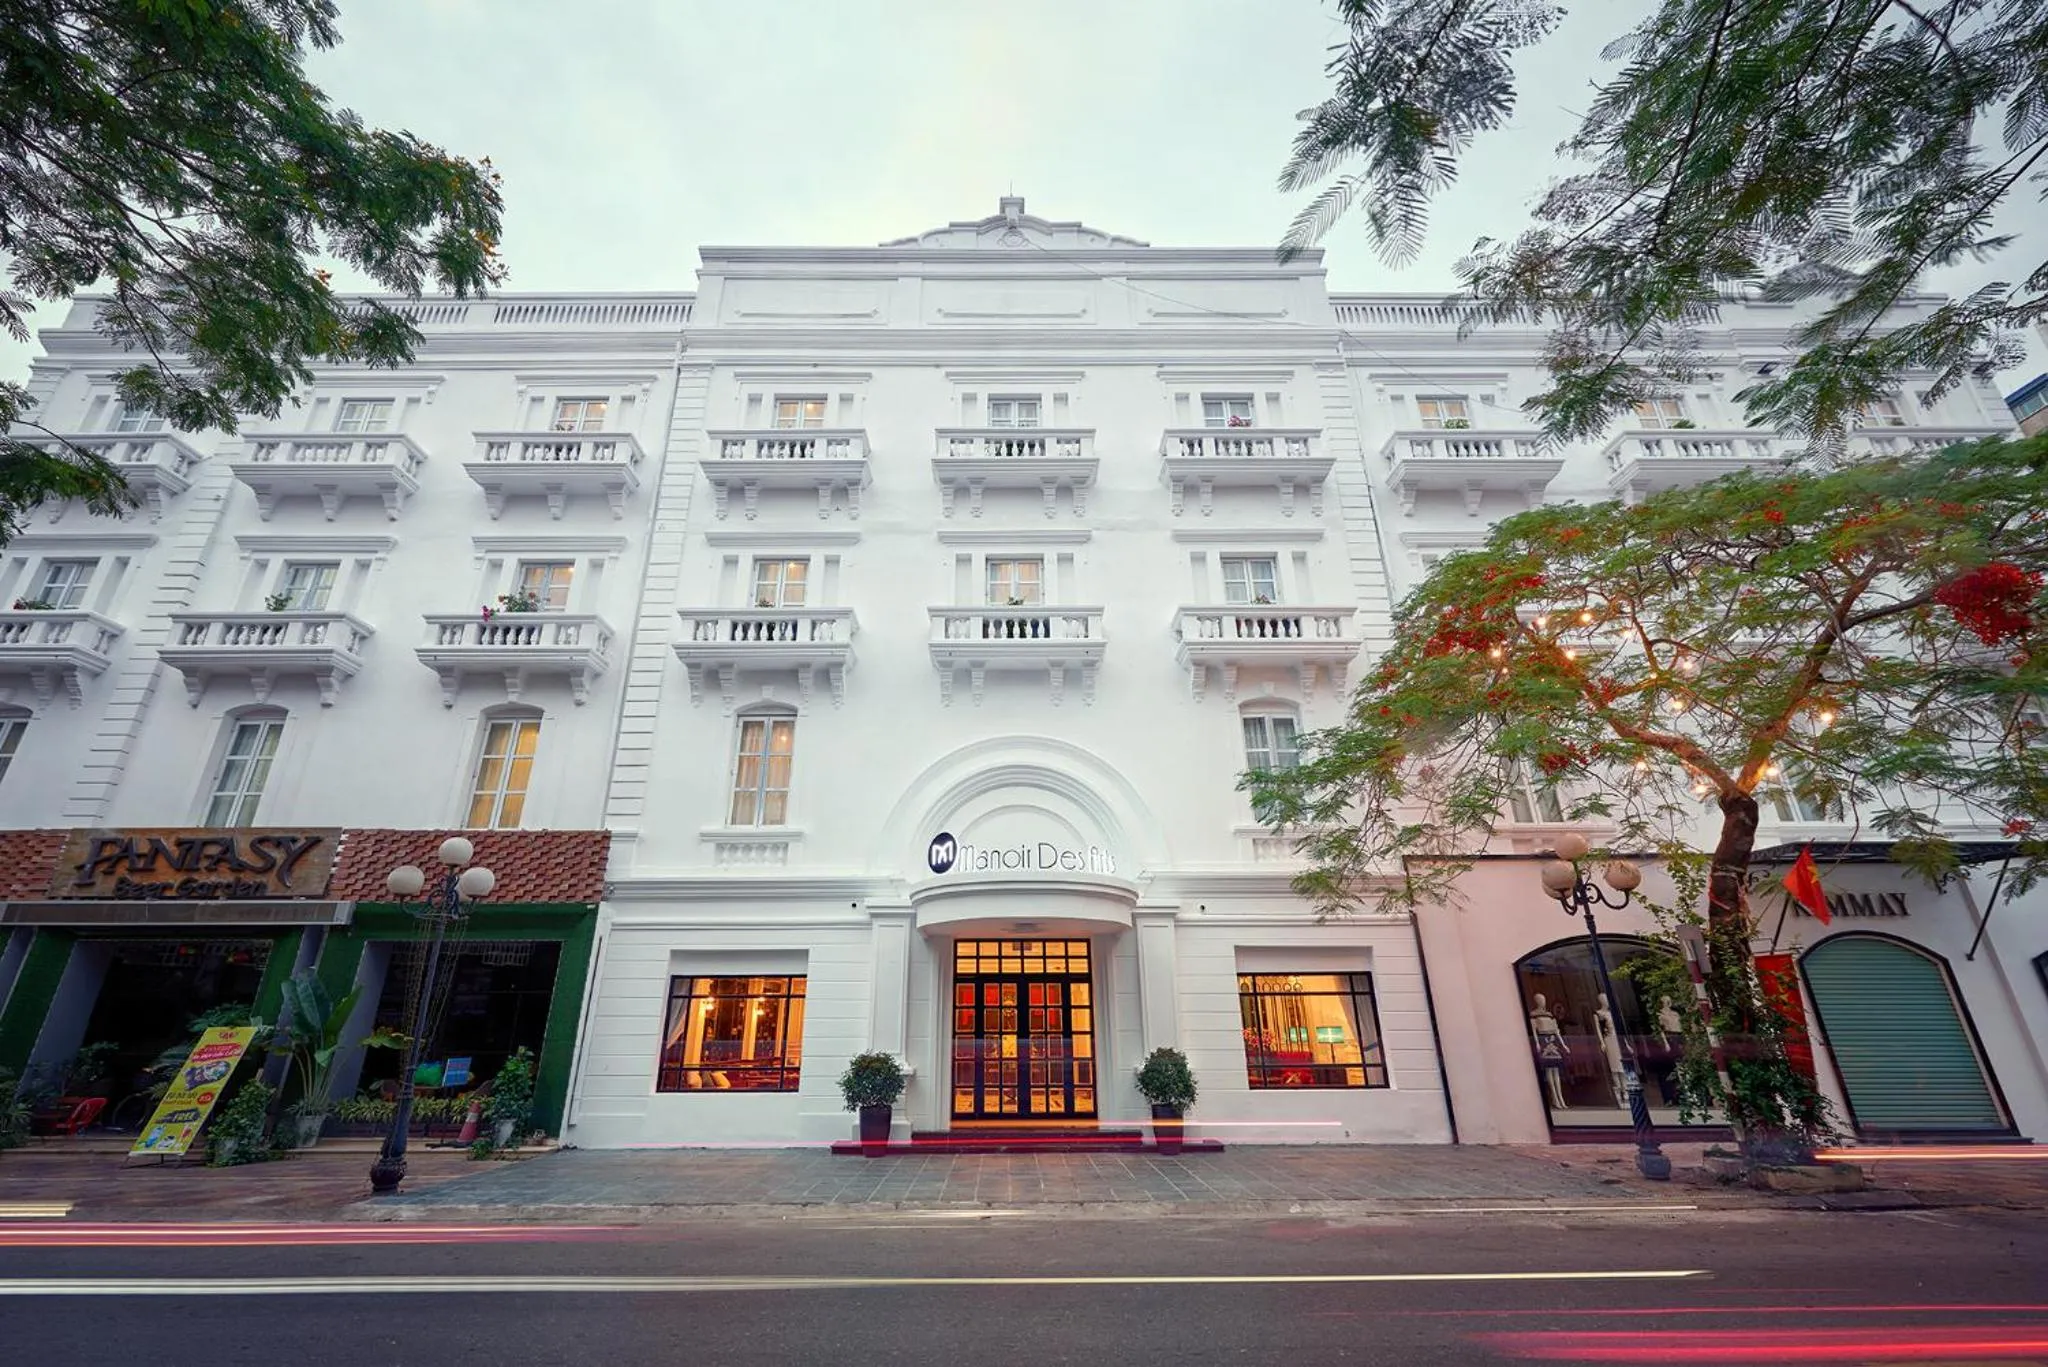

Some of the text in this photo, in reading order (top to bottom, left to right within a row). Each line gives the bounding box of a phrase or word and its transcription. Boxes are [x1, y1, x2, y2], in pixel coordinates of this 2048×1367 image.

[74, 836, 323, 889] FANTASY
[958, 844, 1031, 873] Manoir
[1038, 842, 1086, 871] Des
[114, 876, 269, 898] Beer Garden
